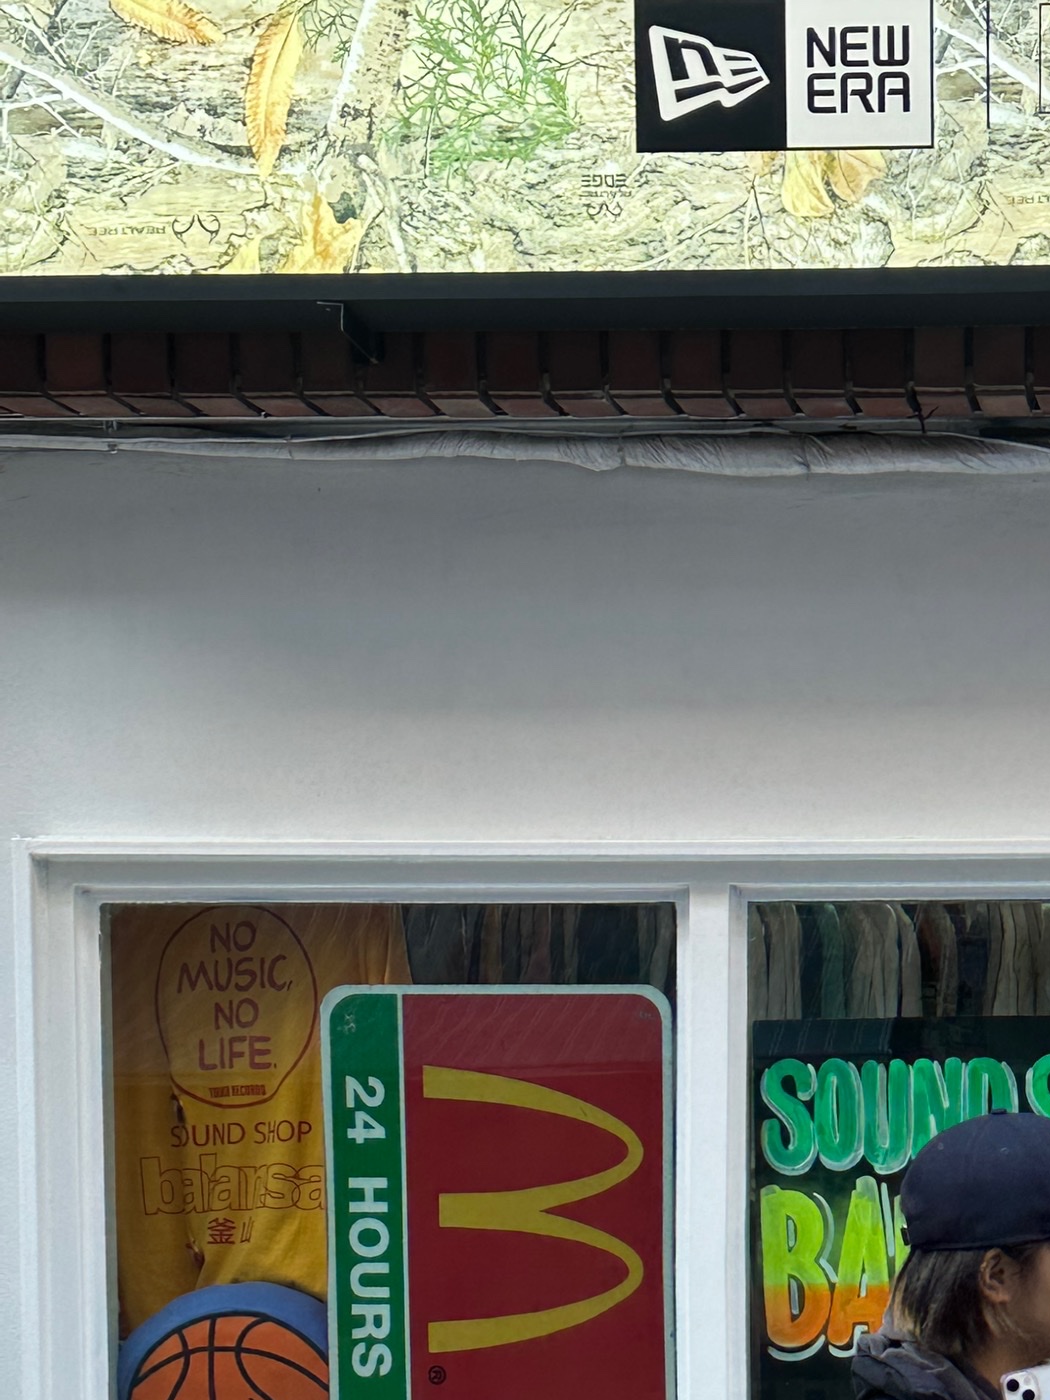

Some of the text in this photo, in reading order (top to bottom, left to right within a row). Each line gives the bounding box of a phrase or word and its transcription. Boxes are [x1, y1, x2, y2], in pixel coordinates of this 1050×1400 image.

[806, 24, 910, 69] NEW
[806, 72, 910, 114] ERA
[209, 920, 257, 953] NO
[176, 954, 293, 994] MUSIC,
[213, 998, 260, 1031] NO
[199, 1035, 278, 1071] LIFE.
[253, 1120, 313, 1144] SHOP
[345, 1075, 393, 1378] 24 HOURS
